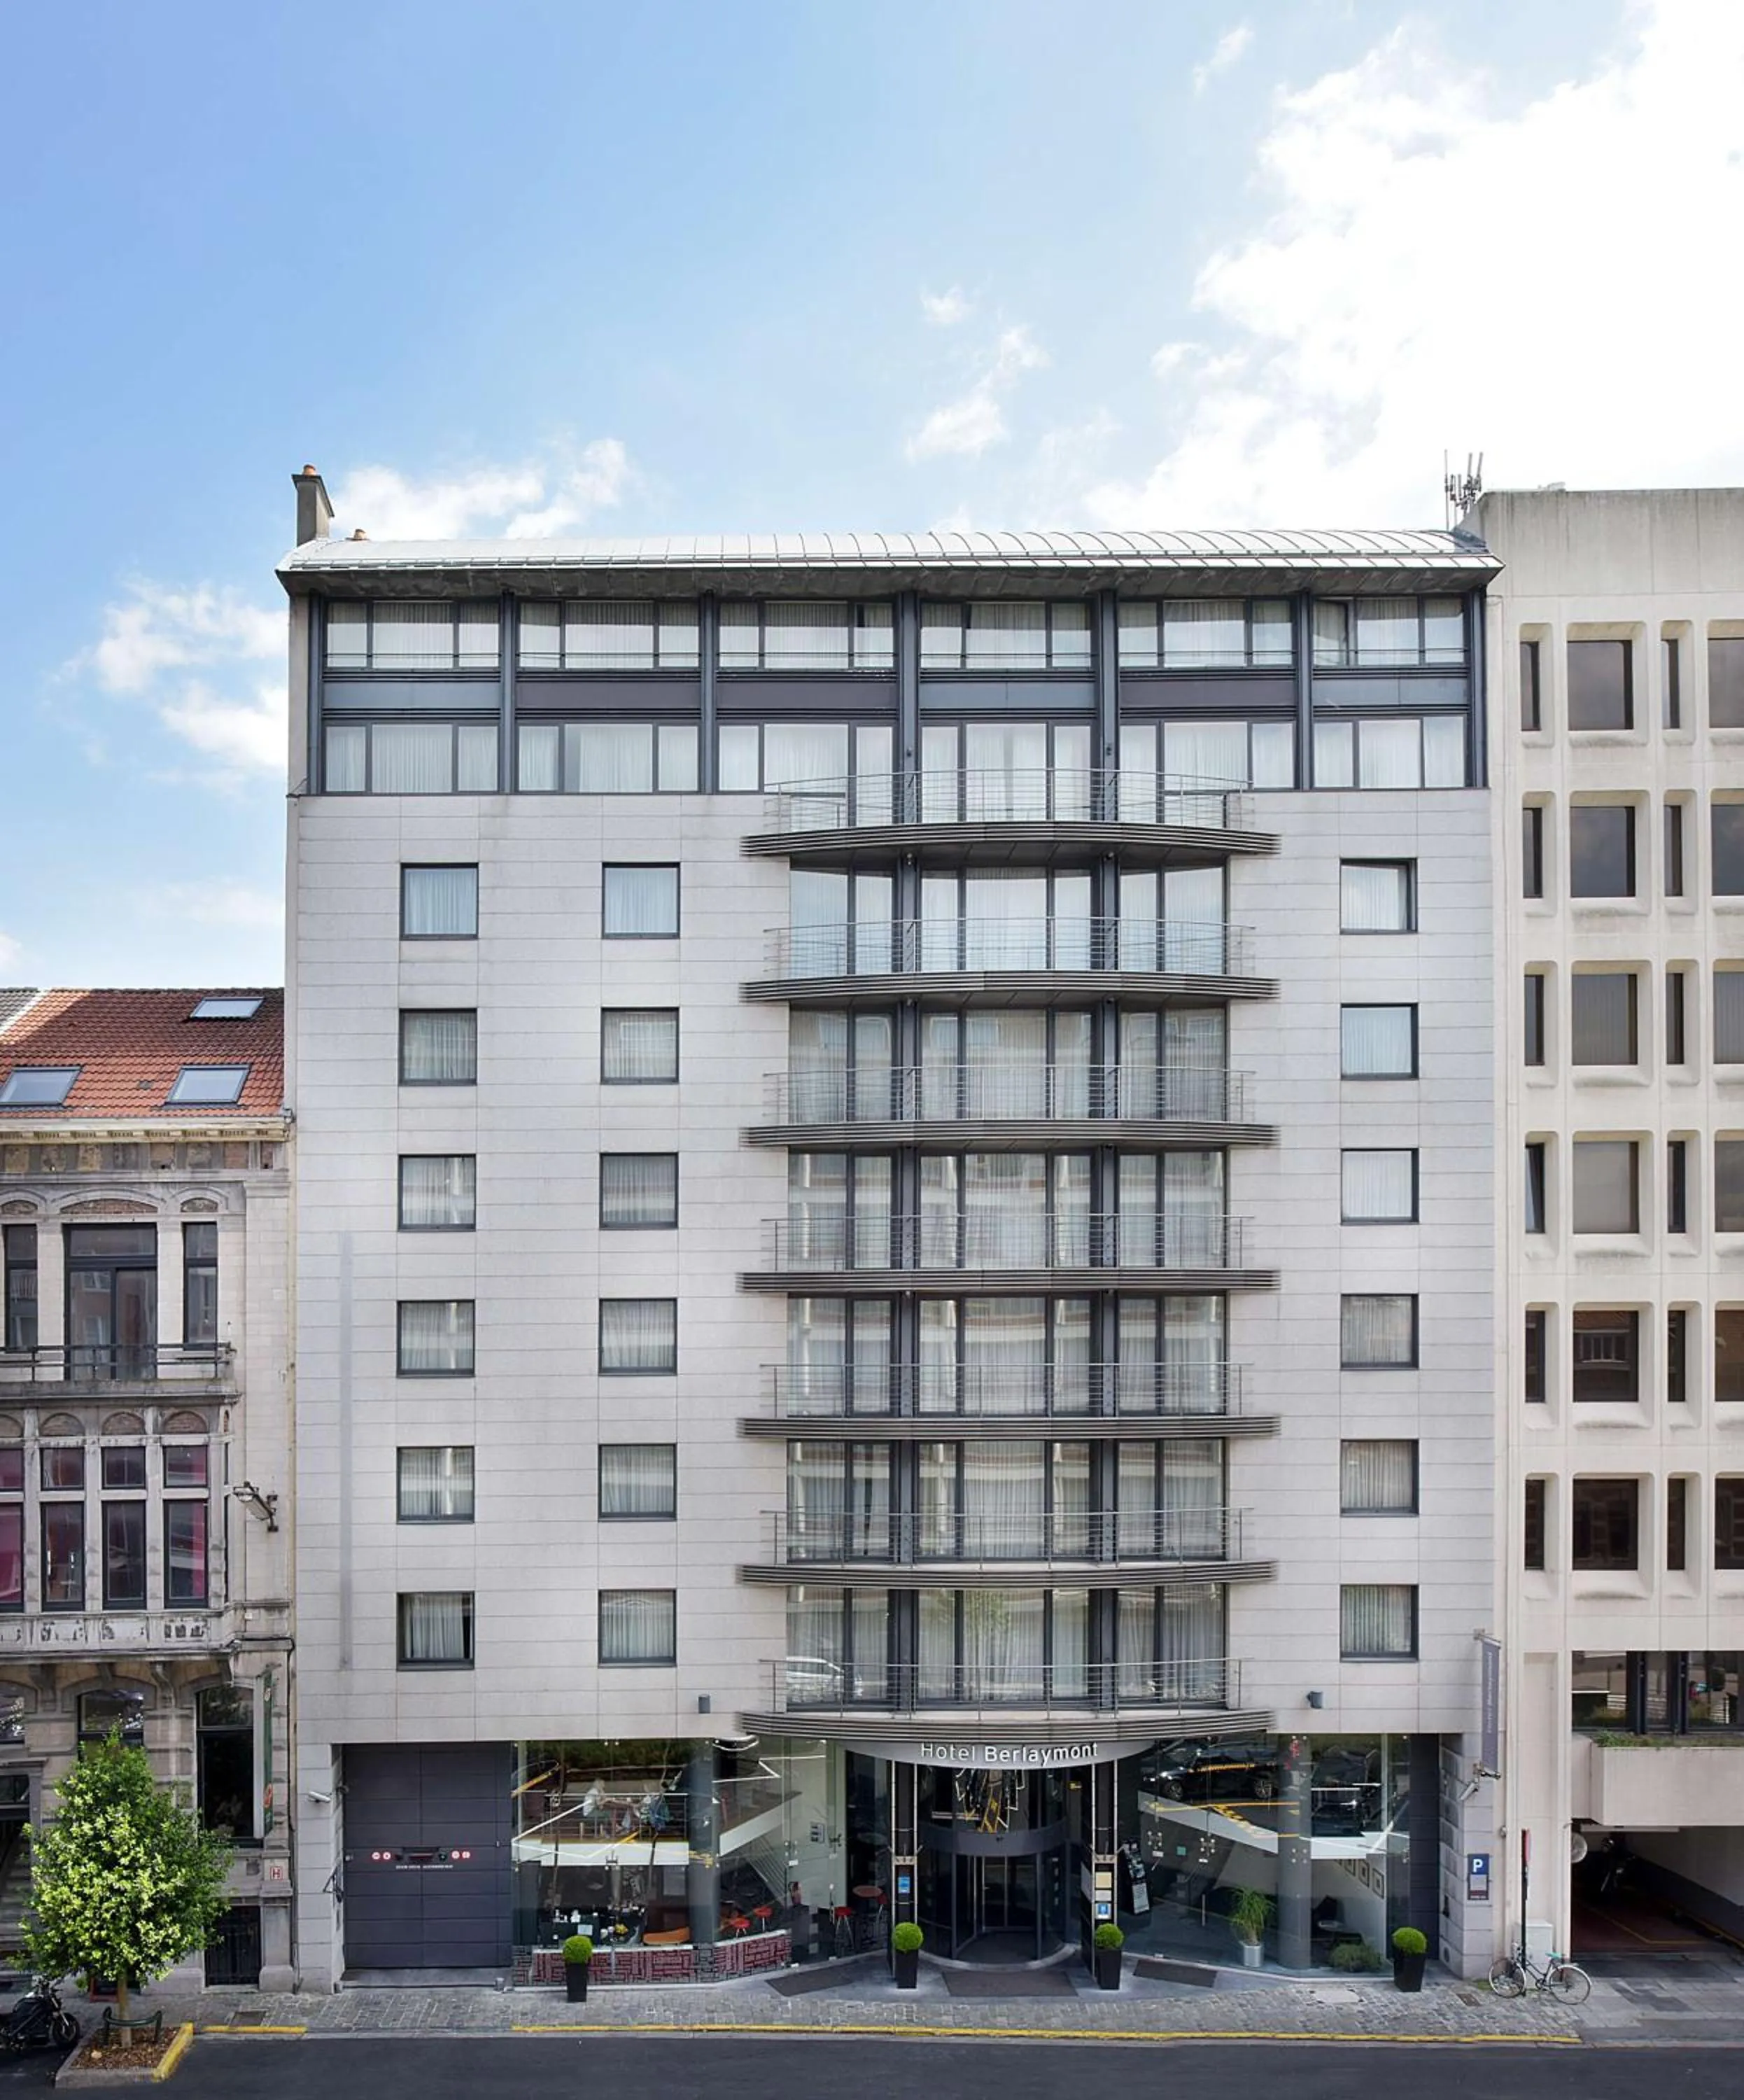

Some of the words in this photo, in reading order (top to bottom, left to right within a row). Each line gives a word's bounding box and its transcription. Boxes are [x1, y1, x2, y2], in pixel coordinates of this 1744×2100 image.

[921, 1742, 976, 1761] Hotel
[985, 1742, 1098, 1767] Berlaymont
[1473, 1858, 1483, 1872] P
